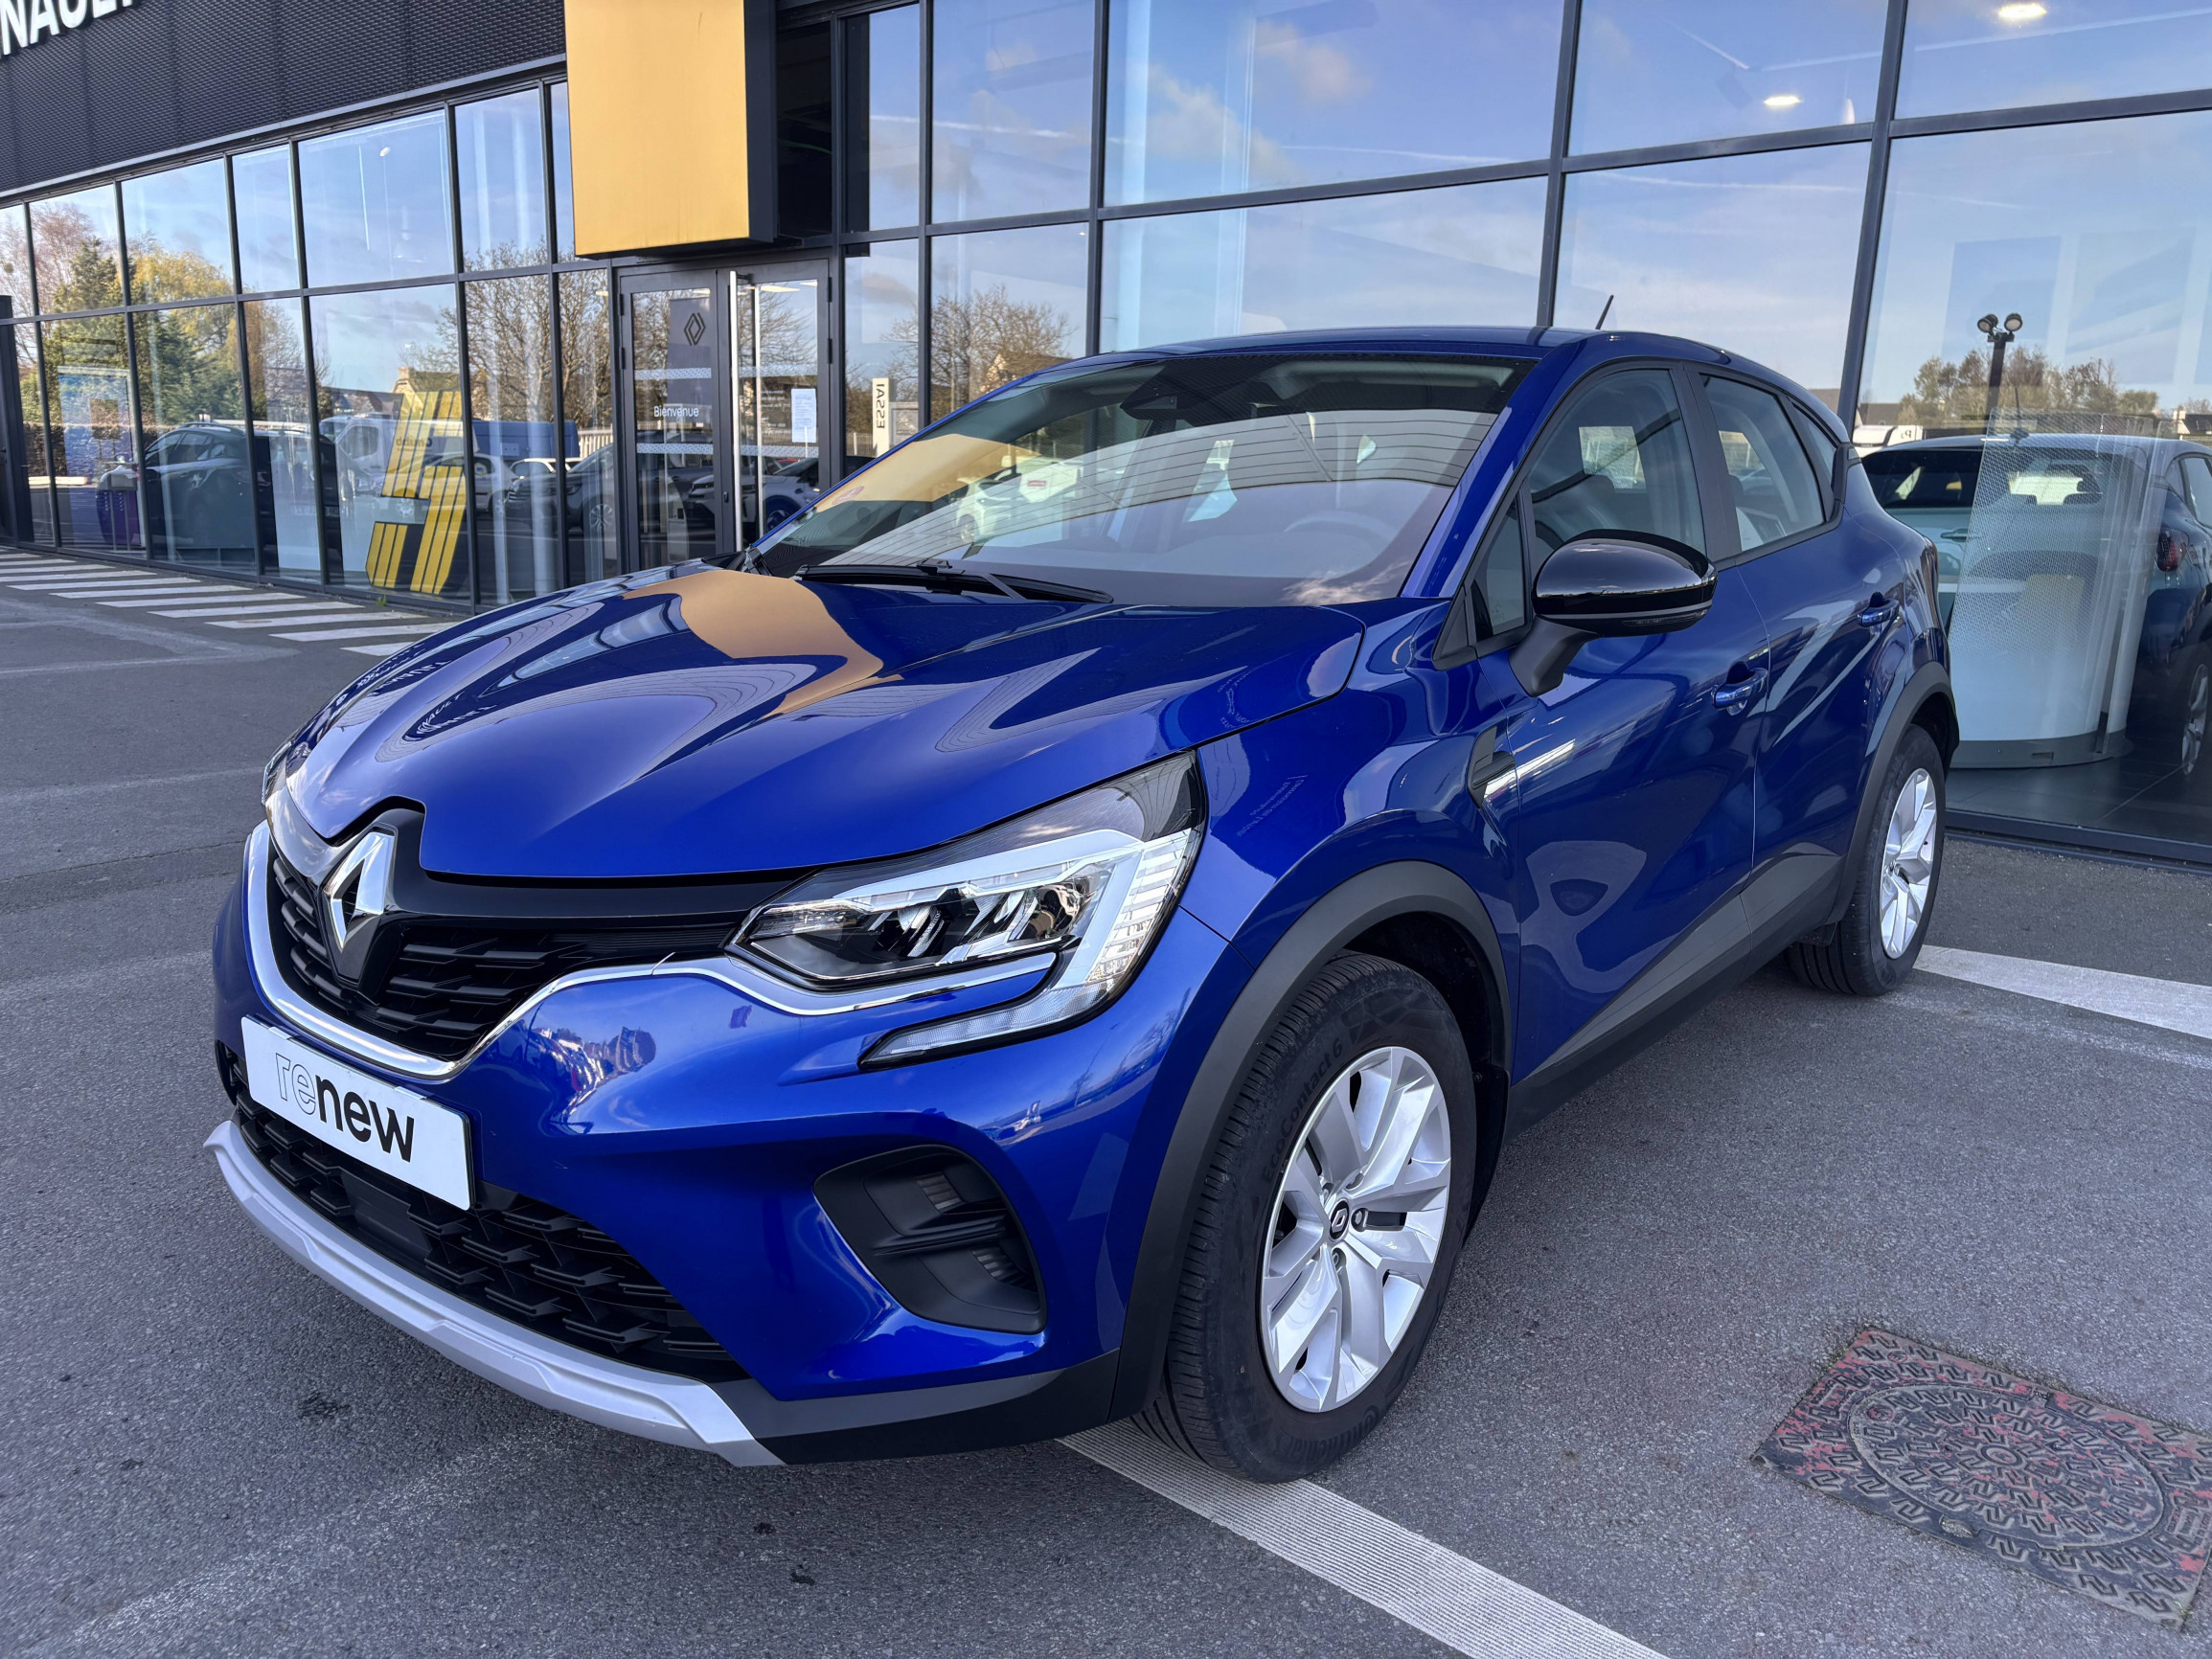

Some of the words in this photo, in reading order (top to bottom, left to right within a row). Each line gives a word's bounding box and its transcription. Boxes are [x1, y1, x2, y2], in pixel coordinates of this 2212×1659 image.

[653, 404, 699, 417] Bienvenue
[275, 1053, 415, 1163] renew
[1262, 1052, 1332, 1183] EcoContact
[1333, 1037, 1343, 1059] 6
